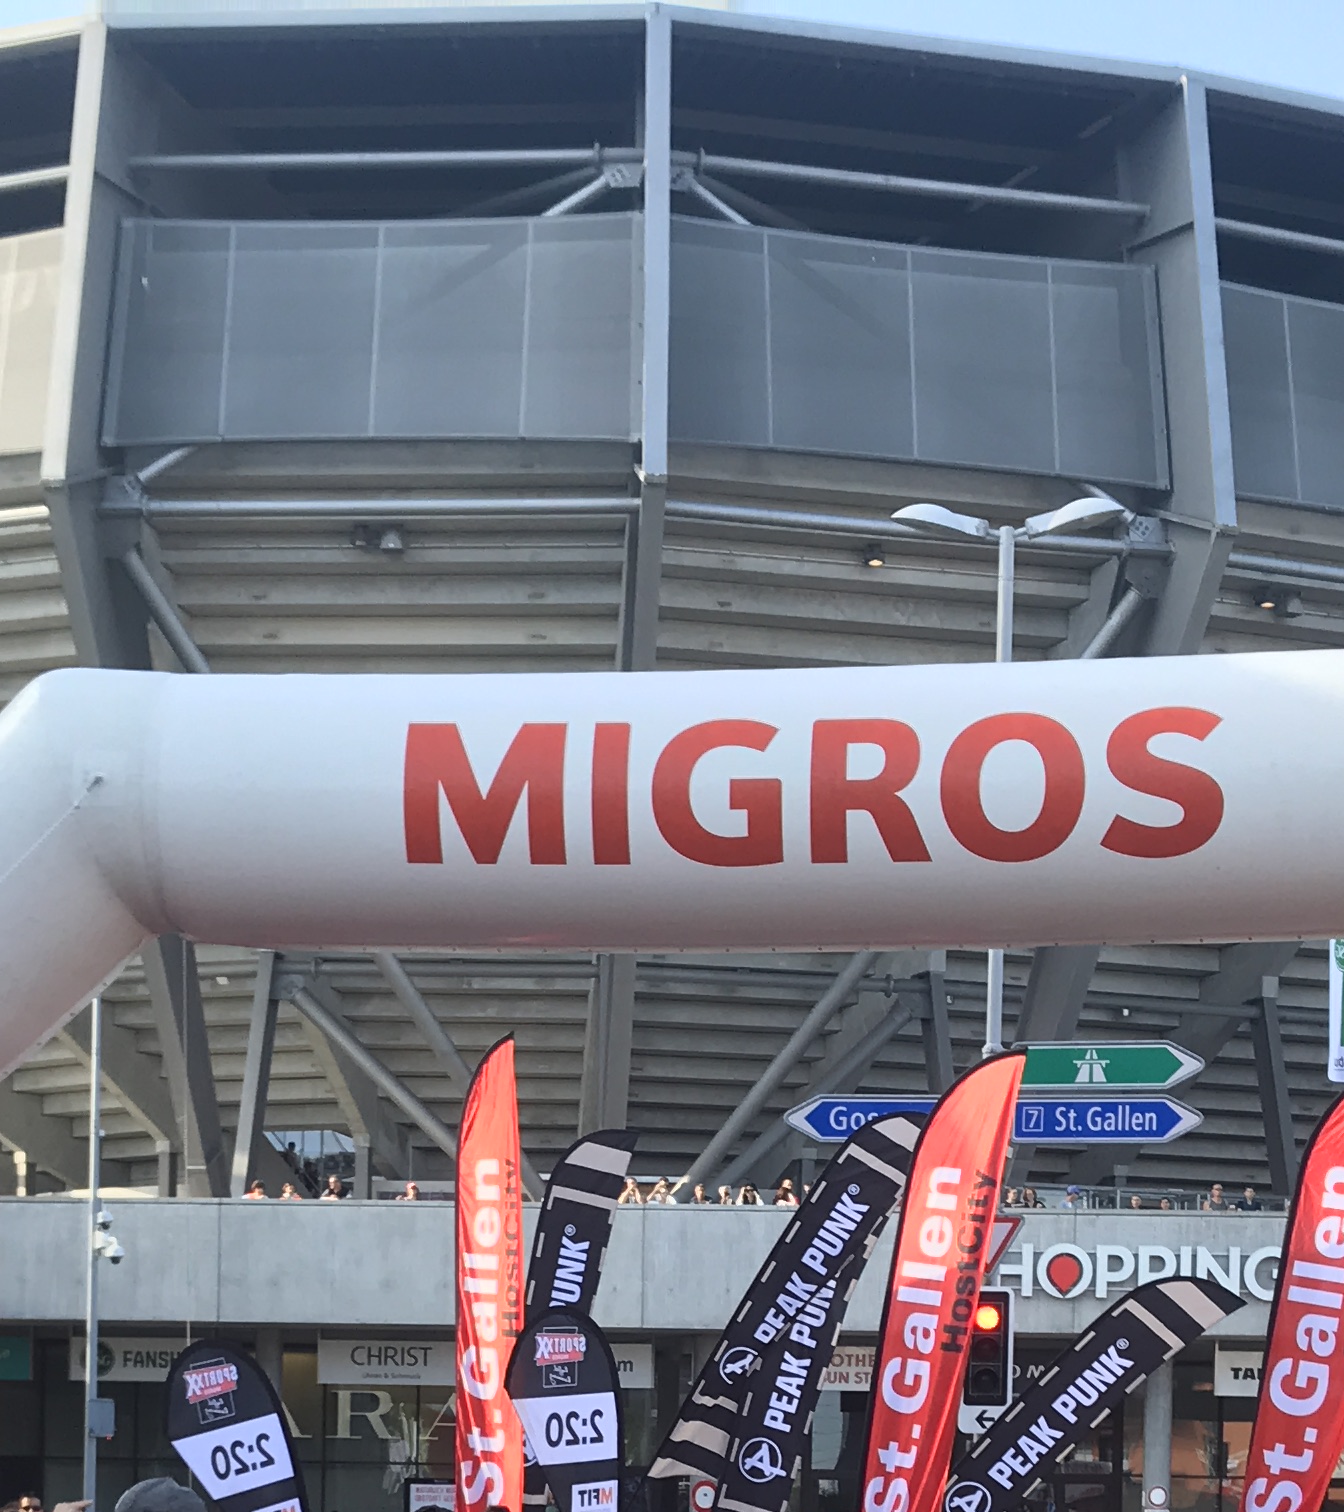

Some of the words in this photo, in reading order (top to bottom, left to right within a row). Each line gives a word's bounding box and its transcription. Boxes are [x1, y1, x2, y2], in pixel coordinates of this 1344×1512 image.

[403, 706, 1226, 868] MIGROS
[829, 1106, 880, 1131] Gos
[1055, 1107, 1083, 1131] St.
[1087, 1107, 1157, 1132] Gallen
[941, 1169, 997, 1354] HostCity
[999, 1242, 1284, 1298] HOPPING
[350, 1345, 433, 1367] CHRIST
[764, 1351, 812, 1434] PEAK
[789, 1280, 838, 1349] PUN
[987, 1415, 1065, 1490] PEAK
